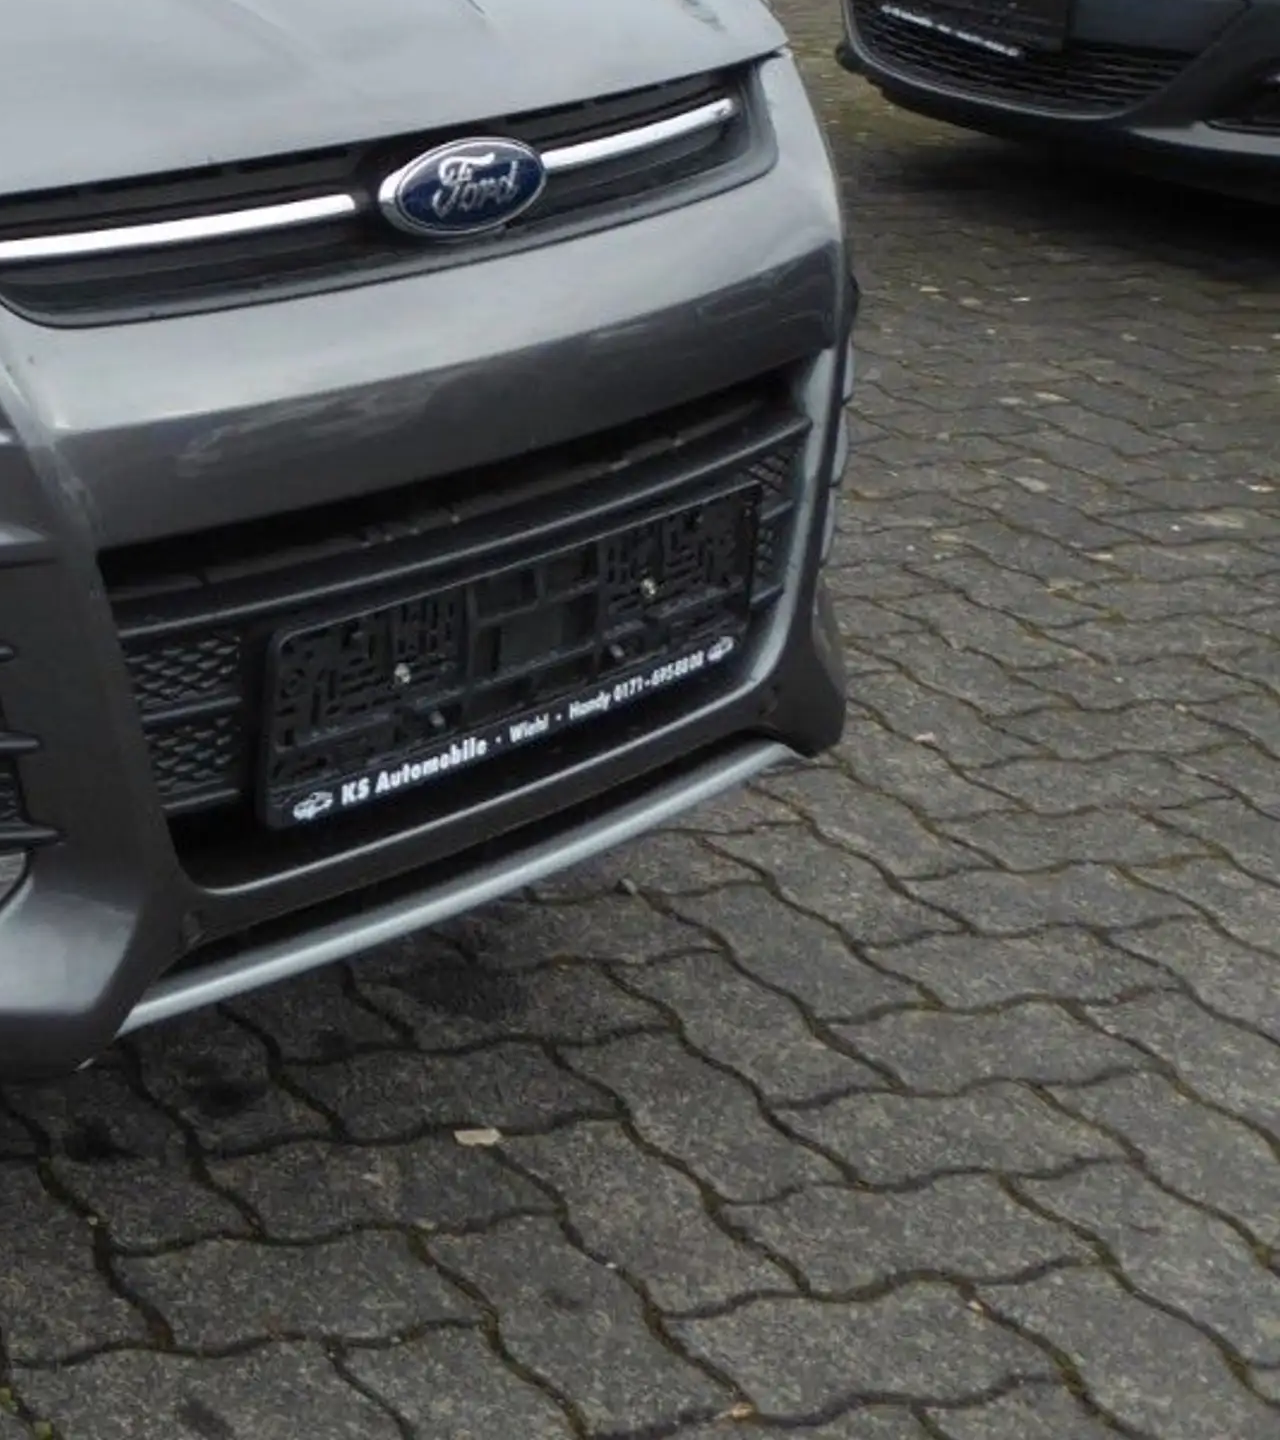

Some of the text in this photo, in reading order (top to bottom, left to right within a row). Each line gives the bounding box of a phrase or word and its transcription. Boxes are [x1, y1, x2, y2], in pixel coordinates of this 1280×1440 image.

[432, 152, 521, 218] Ford
[340, 776, 371, 806] KS
[376, 735, 488, 793] Automobile
[568, 689, 612, 721] Handy
